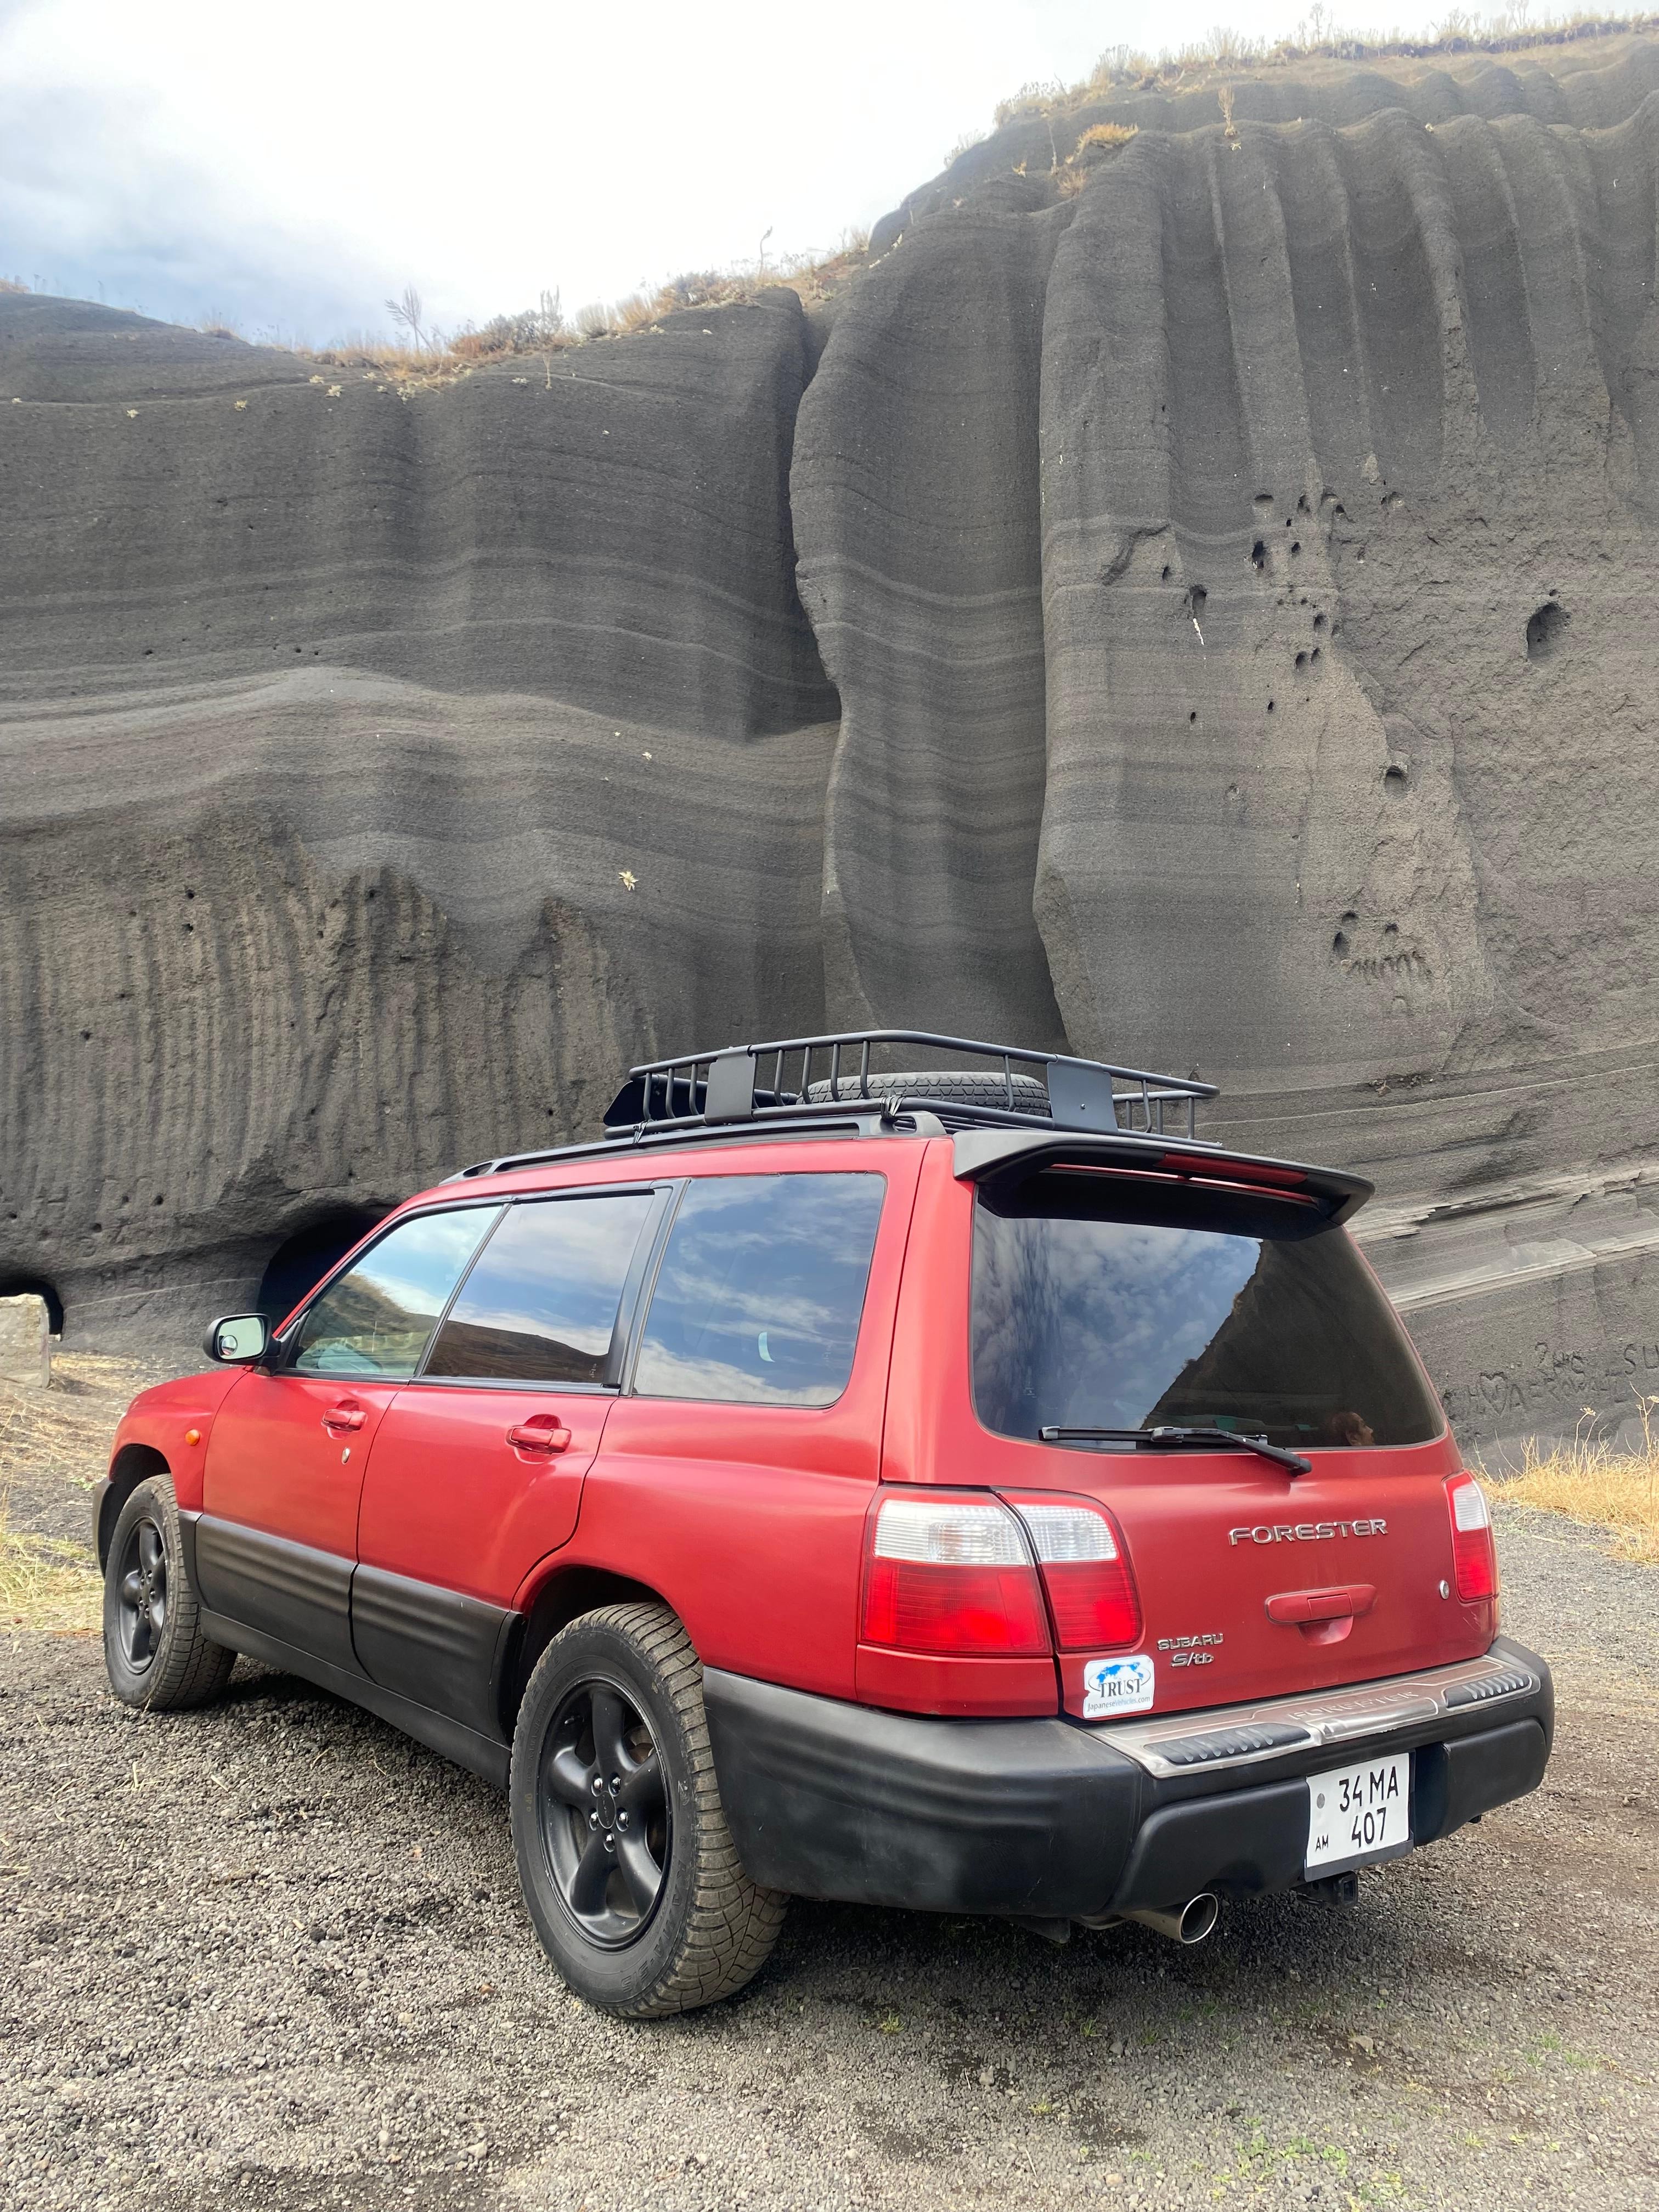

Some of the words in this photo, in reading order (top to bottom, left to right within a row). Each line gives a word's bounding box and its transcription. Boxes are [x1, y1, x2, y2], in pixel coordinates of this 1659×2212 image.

[1229, 1519, 1389, 1546] FORESTER
[1157, 1633, 1224, 1651] SUBARU
[1099, 1678, 1143, 1699] TRUST
[1087, 1696, 1150, 1712] JapaneseVehicles.com
[1351, 1807, 1387, 1848] 407
[1315, 1835, 1329, 1852] AM
